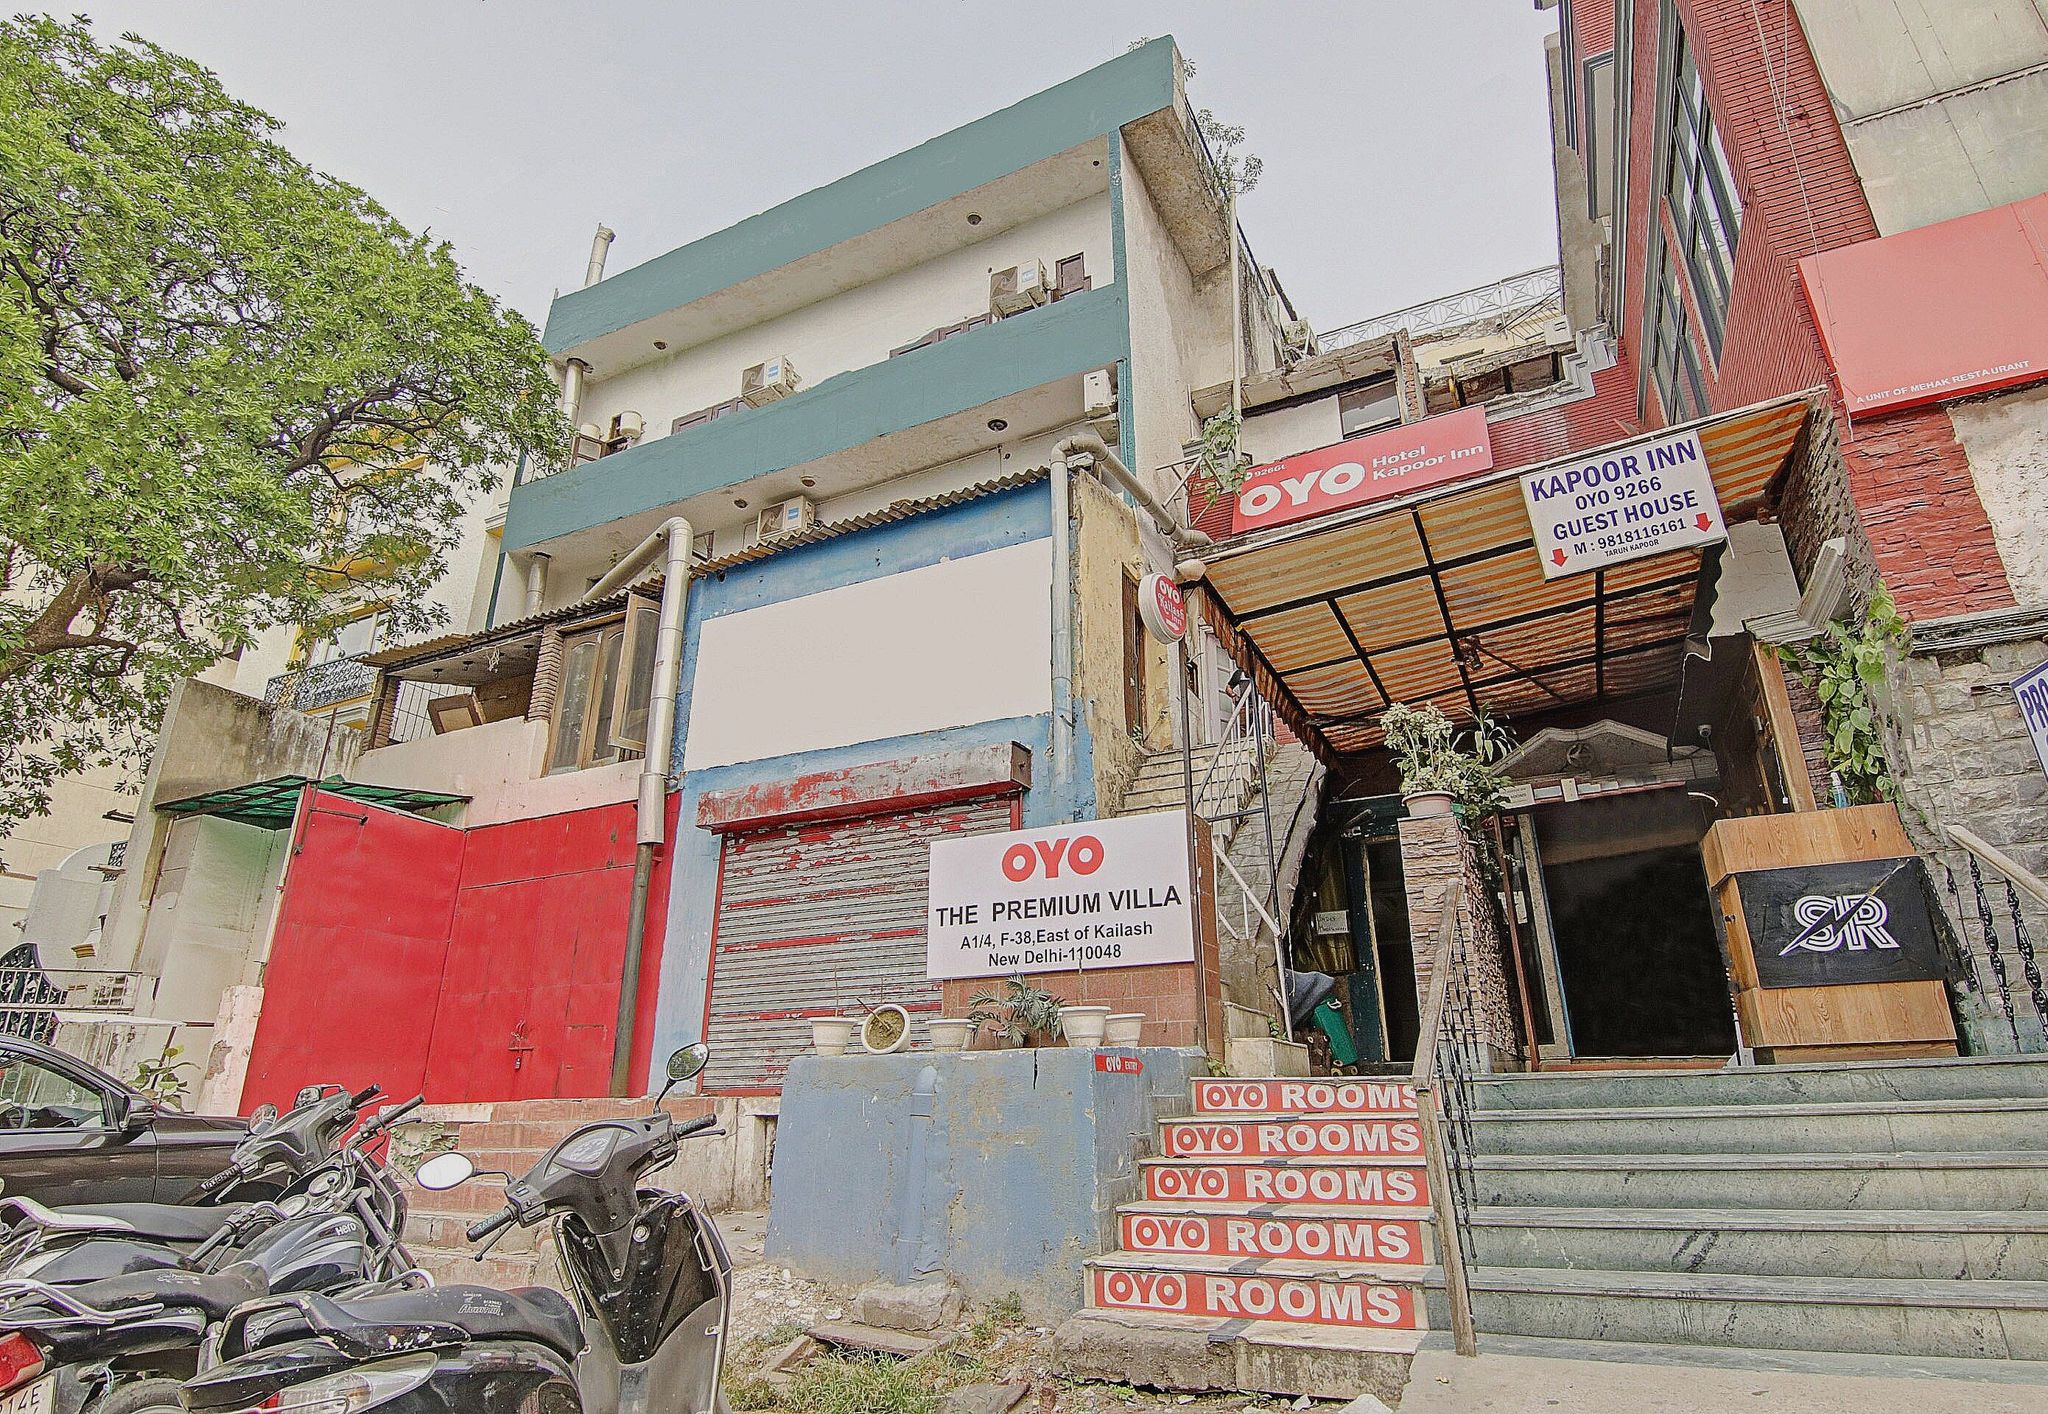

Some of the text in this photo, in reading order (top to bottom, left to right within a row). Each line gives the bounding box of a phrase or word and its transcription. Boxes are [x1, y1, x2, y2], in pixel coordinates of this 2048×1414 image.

[1866, 390, 1890, 402] UNIT
[1893, 388, 1908, 397] OF
[1911, 378, 1951, 392] MEHAK
[1952, 360, 2030, 383] RESTAURANT
[1372, 446, 1426, 468] Hotel
[1373, 445, 1484, 480] Kapoor Inn
[1531, 439, 1697, 502] KAPOOR INN
[1240, 462, 1366, 517] OYO
[1576, 476, 1662, 510] OYO 9266
[1553, 490, 1698, 540] GUEST HOUSE
[1598, 518, 1687, 550] 9818116161
[1605, 539, 1659, 557] TARUN KAPOOR
[1160, 580, 1180, 604] OYO
[1002, 835, 1104, 882] OYO
[936, 885, 1182, 926] THE PREMIUM VILLA
[961, 934, 996, 950] A1/4,
[1074, 926, 1089, 940] of
[1095, 921, 1153, 939] Kailash
[988, 944, 1122, 967] New Delhi-110048
[1106, 1056, 1122, 1071] OYO
[1206, 1085, 1418, 1109] OYO ROOMS
[1175, 1124, 1420, 1152] OYO ROOMS
[1158, 1168, 1417, 1201] OYO ROOMS
[334, 1223, 357, 1236] Hero
[1135, 1219, 1411, 1259] OYO ROOMS
[1108, 1272, 1402, 1324] OYO ROOMS
